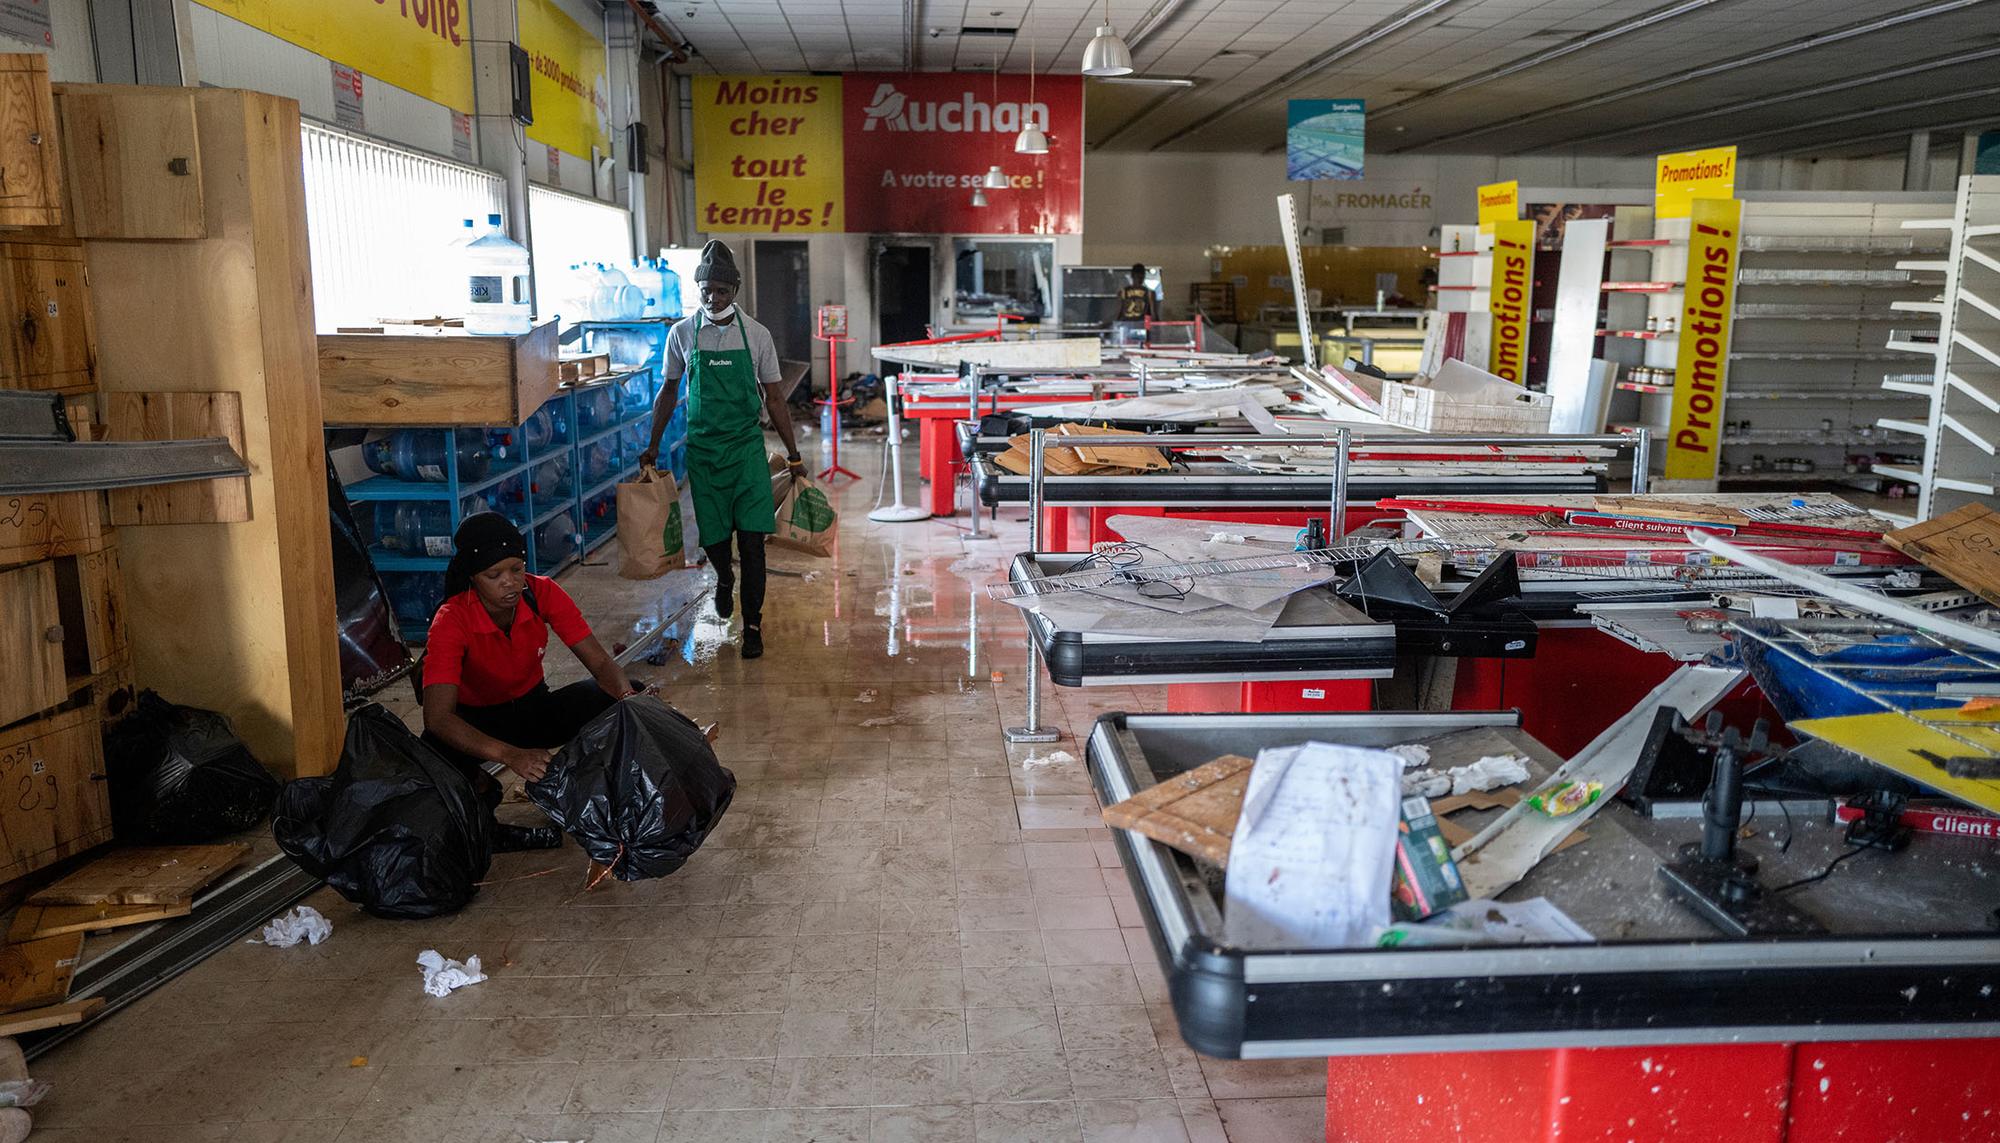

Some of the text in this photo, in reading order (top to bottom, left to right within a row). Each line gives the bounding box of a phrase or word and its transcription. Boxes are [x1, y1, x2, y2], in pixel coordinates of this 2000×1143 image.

[716, 79, 819, 105] Moins
[863, 83, 1050, 132] Auchan
[730, 110, 805, 136] cher
[731, 154, 807, 178] tout
[881, 169, 897, 187] A
[901, 171, 956, 188] votre
[1661, 159, 1723, 184] Promotions
[756, 181, 786, 206] le
[705, 202, 813, 233] temps
[1675, 246, 1730, 453] Promotions
[708, 359, 732, 367] Auchan
[1615, 520, 1683, 534] Client suivant
[1931, 816, 1992, 836] Client
